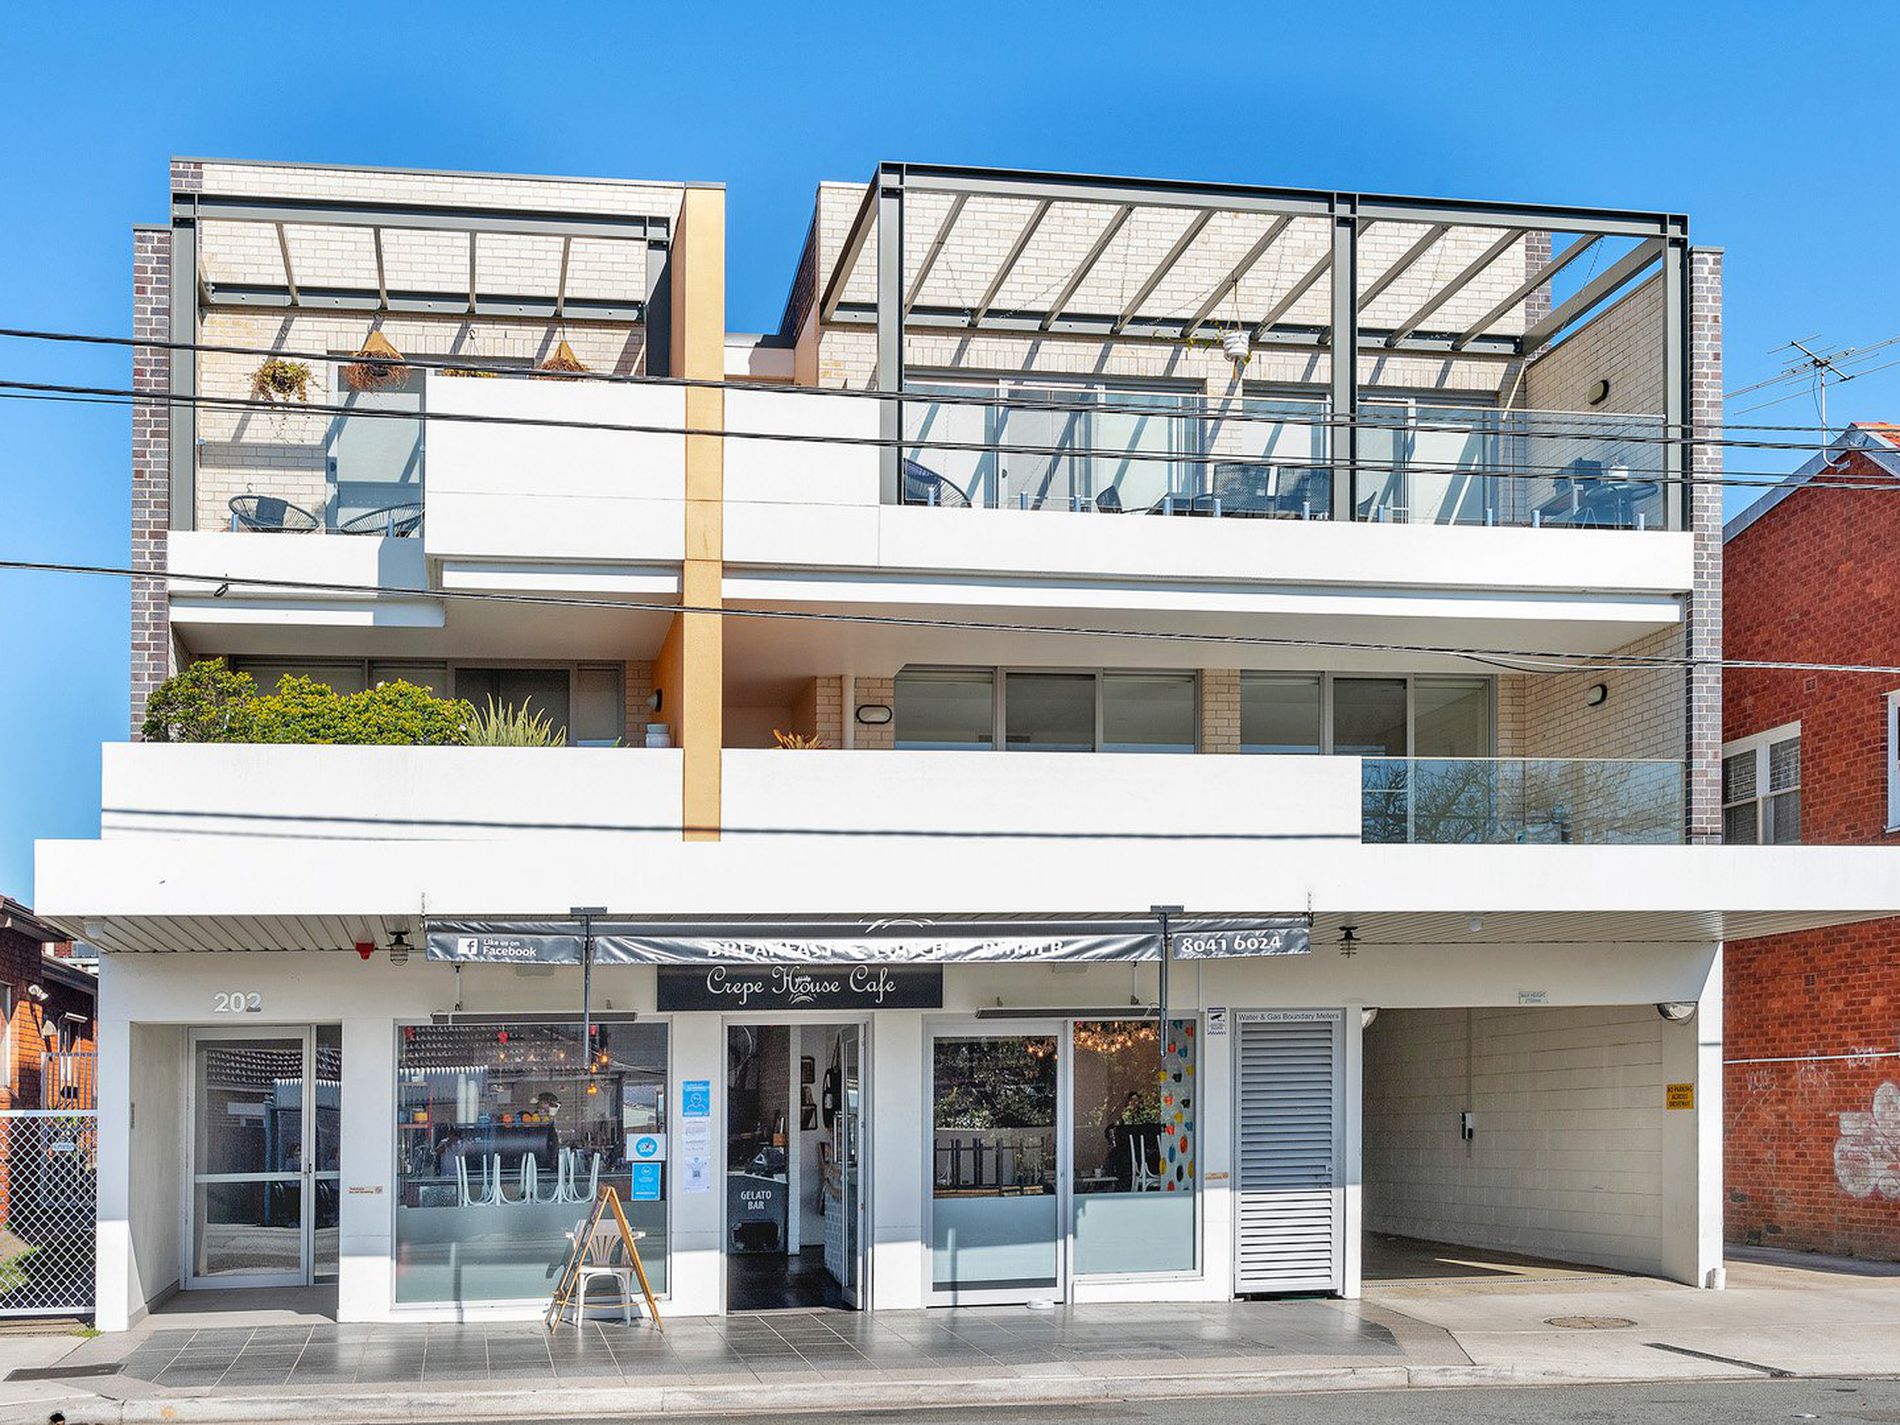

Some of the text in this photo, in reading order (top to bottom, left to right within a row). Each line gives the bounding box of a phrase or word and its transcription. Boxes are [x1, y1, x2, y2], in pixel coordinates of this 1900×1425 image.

[483, 938, 498, 946] Like
[1181, 935, 1283, 952] 8041 6024
[483, 946, 537, 957] Facebook
[706, 964, 896, 1006] Crepe House Cafe
[213, 991, 262, 1013] 202
[1238, 1012, 1258, 1020] Water
[1266, 1012, 1281, 1020] Gas
[1282, 1012, 1315, 1021] Boundary
[1316, 1011, 1340, 1019] Meters
[740, 1190, 772, 1200] GELATO
[747, 1201, 765, 1210] BAR
